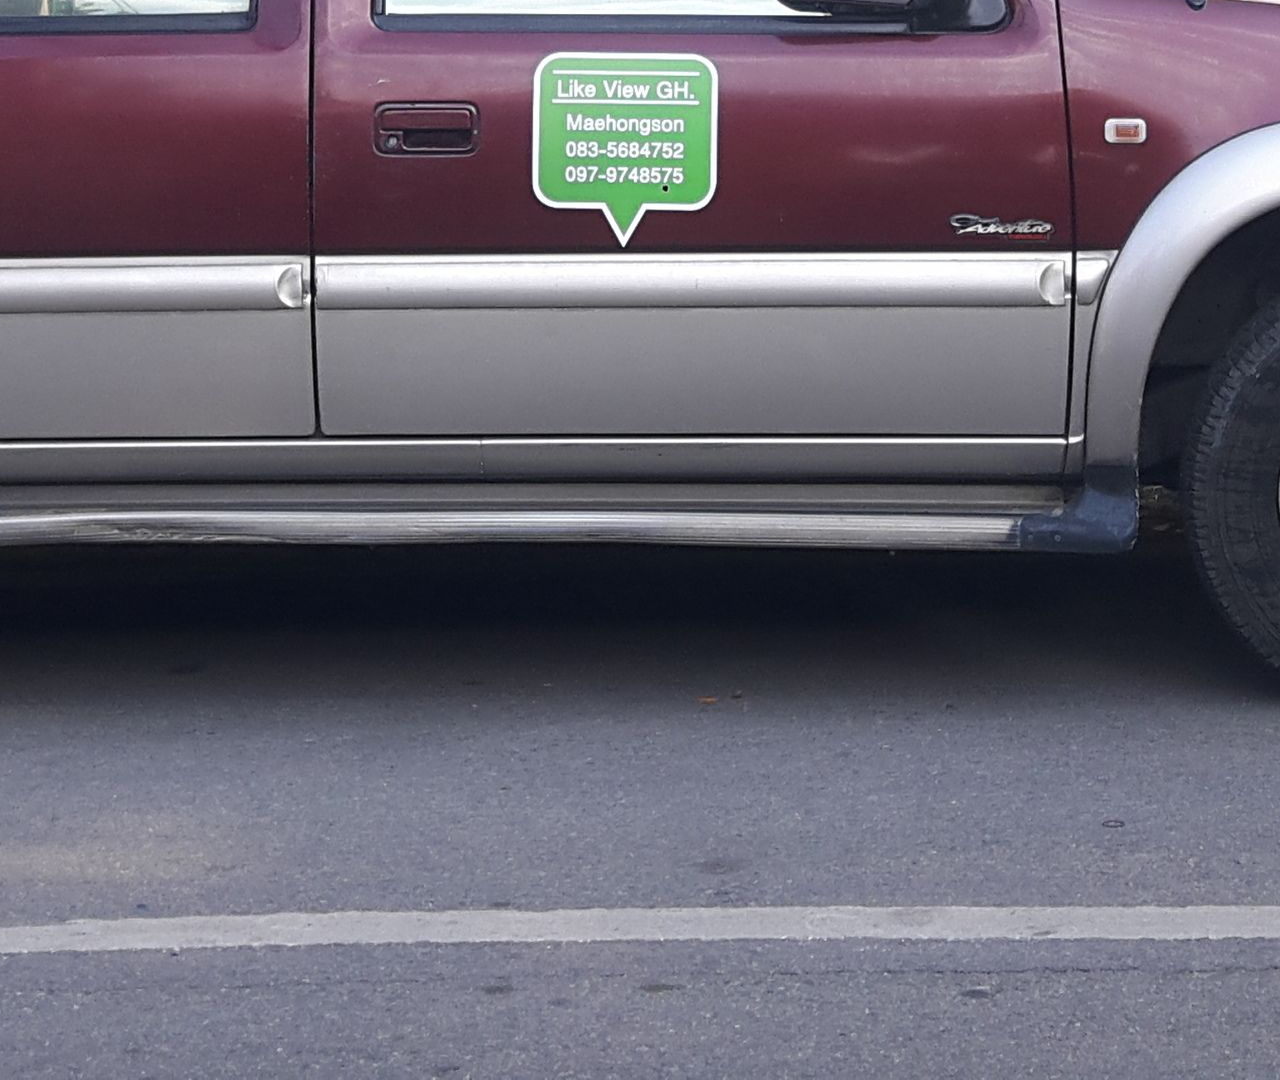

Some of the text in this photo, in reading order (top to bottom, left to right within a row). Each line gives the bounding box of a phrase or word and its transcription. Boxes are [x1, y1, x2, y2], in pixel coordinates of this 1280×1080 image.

[558, 80, 694, 99] Like View GH.
[567, 114, 684, 135] Maehongson
[566, 141, 683, 158] 083-5684752
[566, 166, 683, 183] 097-9748575
